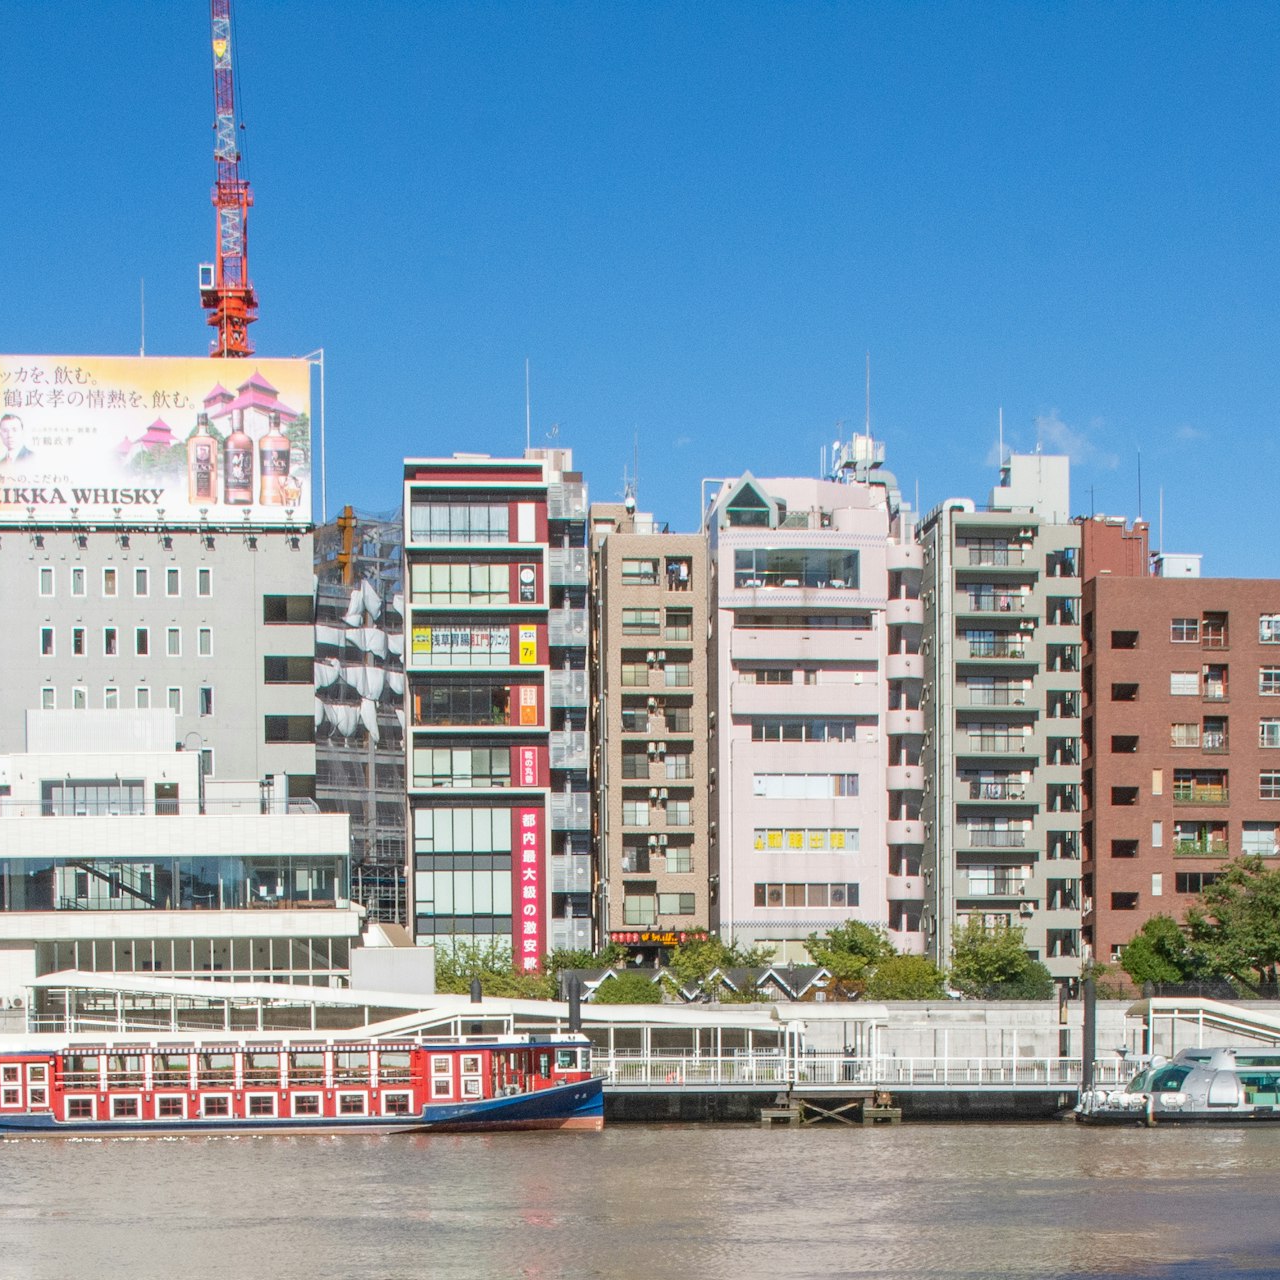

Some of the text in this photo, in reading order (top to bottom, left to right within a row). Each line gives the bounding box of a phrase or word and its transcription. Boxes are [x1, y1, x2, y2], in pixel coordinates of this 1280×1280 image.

[71, 488, 165, 504] WHISKY
[522, 814, 537, 970] 都内最大級の激安靴
